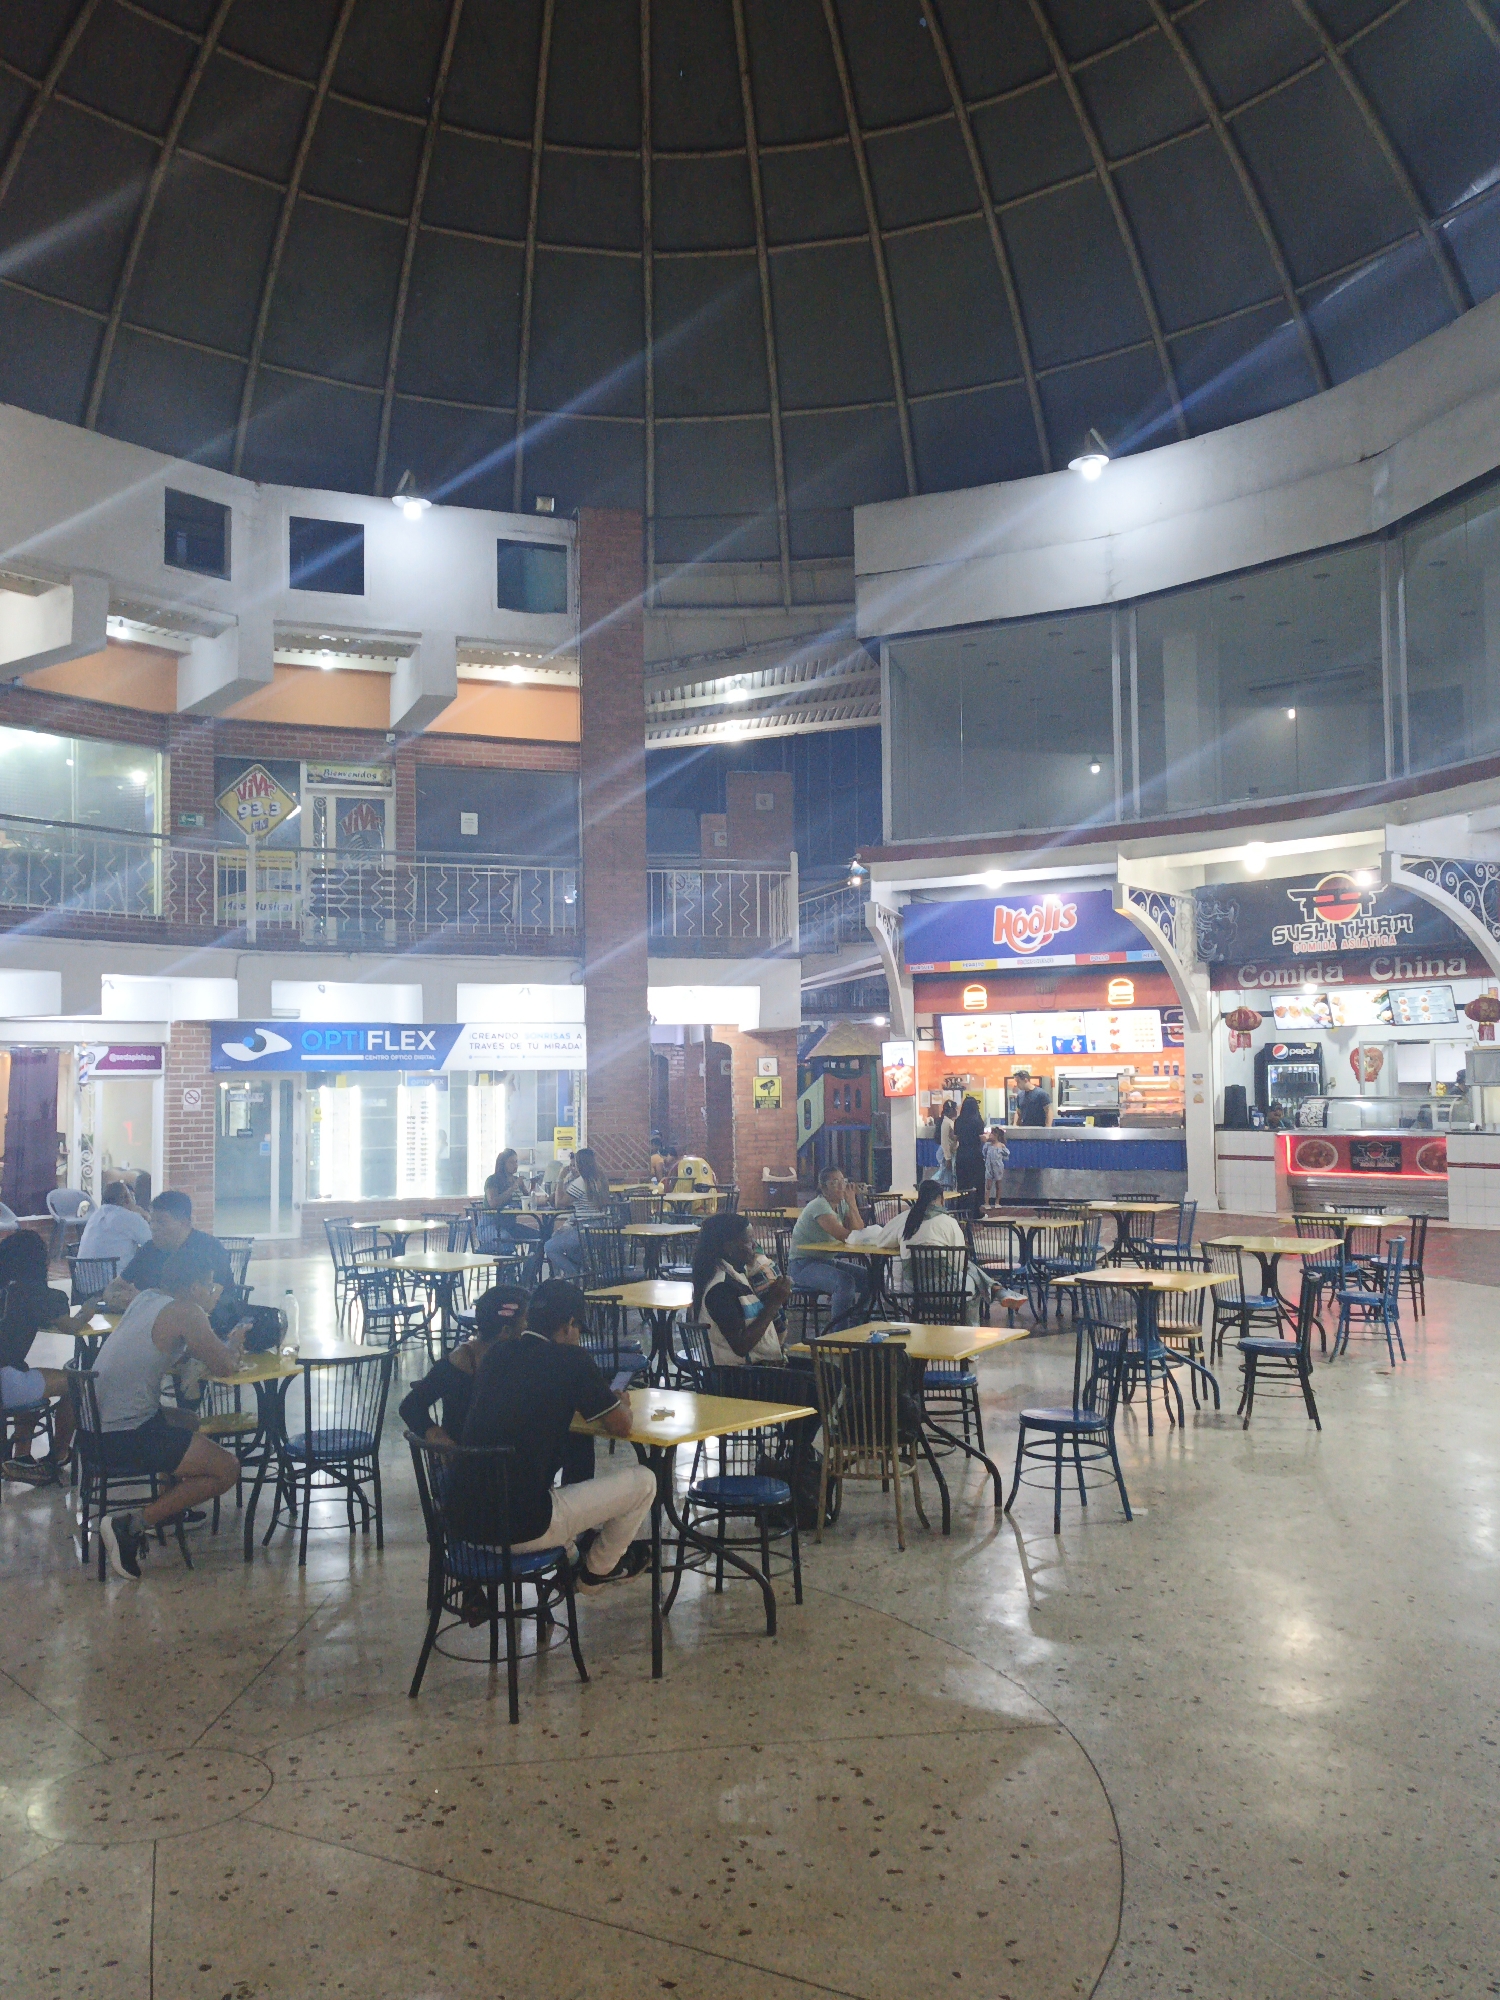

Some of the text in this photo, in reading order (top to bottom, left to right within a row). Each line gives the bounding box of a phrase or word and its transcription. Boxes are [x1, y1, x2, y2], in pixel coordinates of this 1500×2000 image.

[237, 800, 282, 821] 93.3
[1272, 922, 1337, 945] SUSHI
[1293, 935, 1397, 954] COMIDA ASIATICA
[1237, 956, 1468, 988] Comida China
[301, 1029, 436, 1051] OPTIFLEX
[510, 1042, 522, 1050] DE
[524, 1032, 571, 1040] SONRISAS
[1289, 1048, 1315, 1056] pepsi
